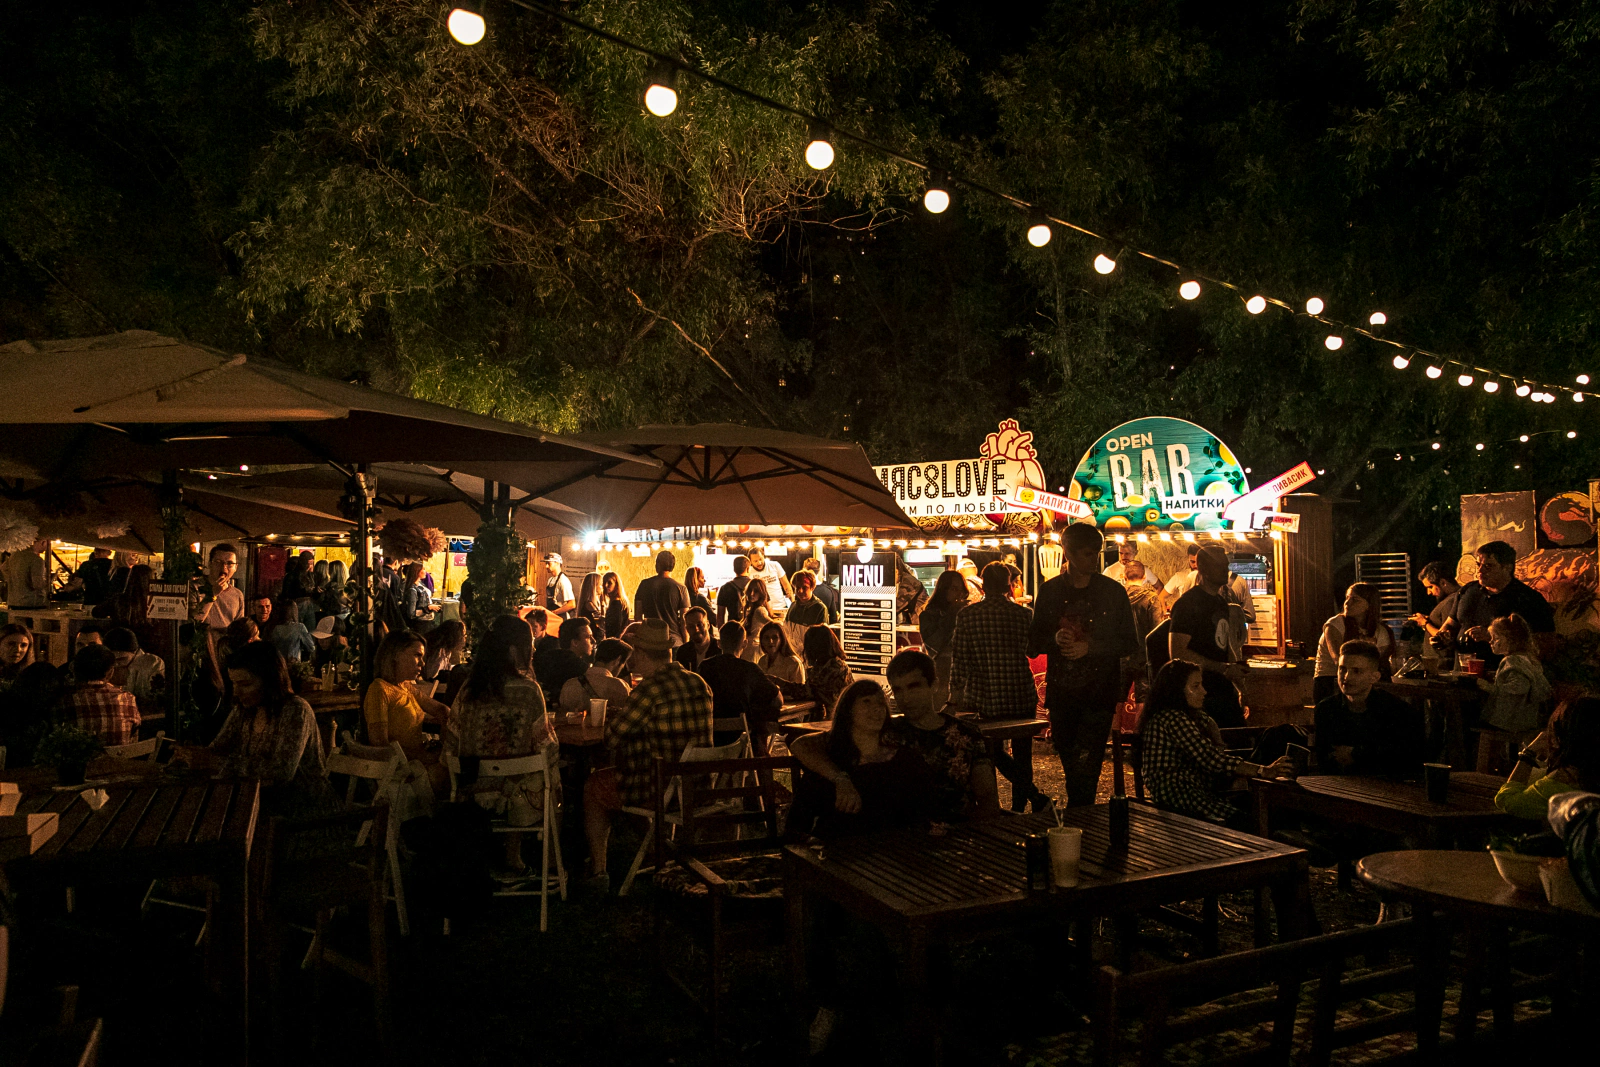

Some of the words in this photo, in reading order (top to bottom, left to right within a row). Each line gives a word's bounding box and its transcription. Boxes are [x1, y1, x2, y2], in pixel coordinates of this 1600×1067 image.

[1106, 432, 1154, 452] OPEN
[1109, 443, 1196, 509] BAR
[1272, 469, 1308, 493] ПИВАСИК
[926, 505, 945, 515] ПО
[953, 502, 1008, 514] ЛЮБВИ
[1038, 494, 1081, 514] НАПИТКИ
[1165, 499, 1225, 509] НАПИТКИ
[842, 564, 884, 587] MENU
